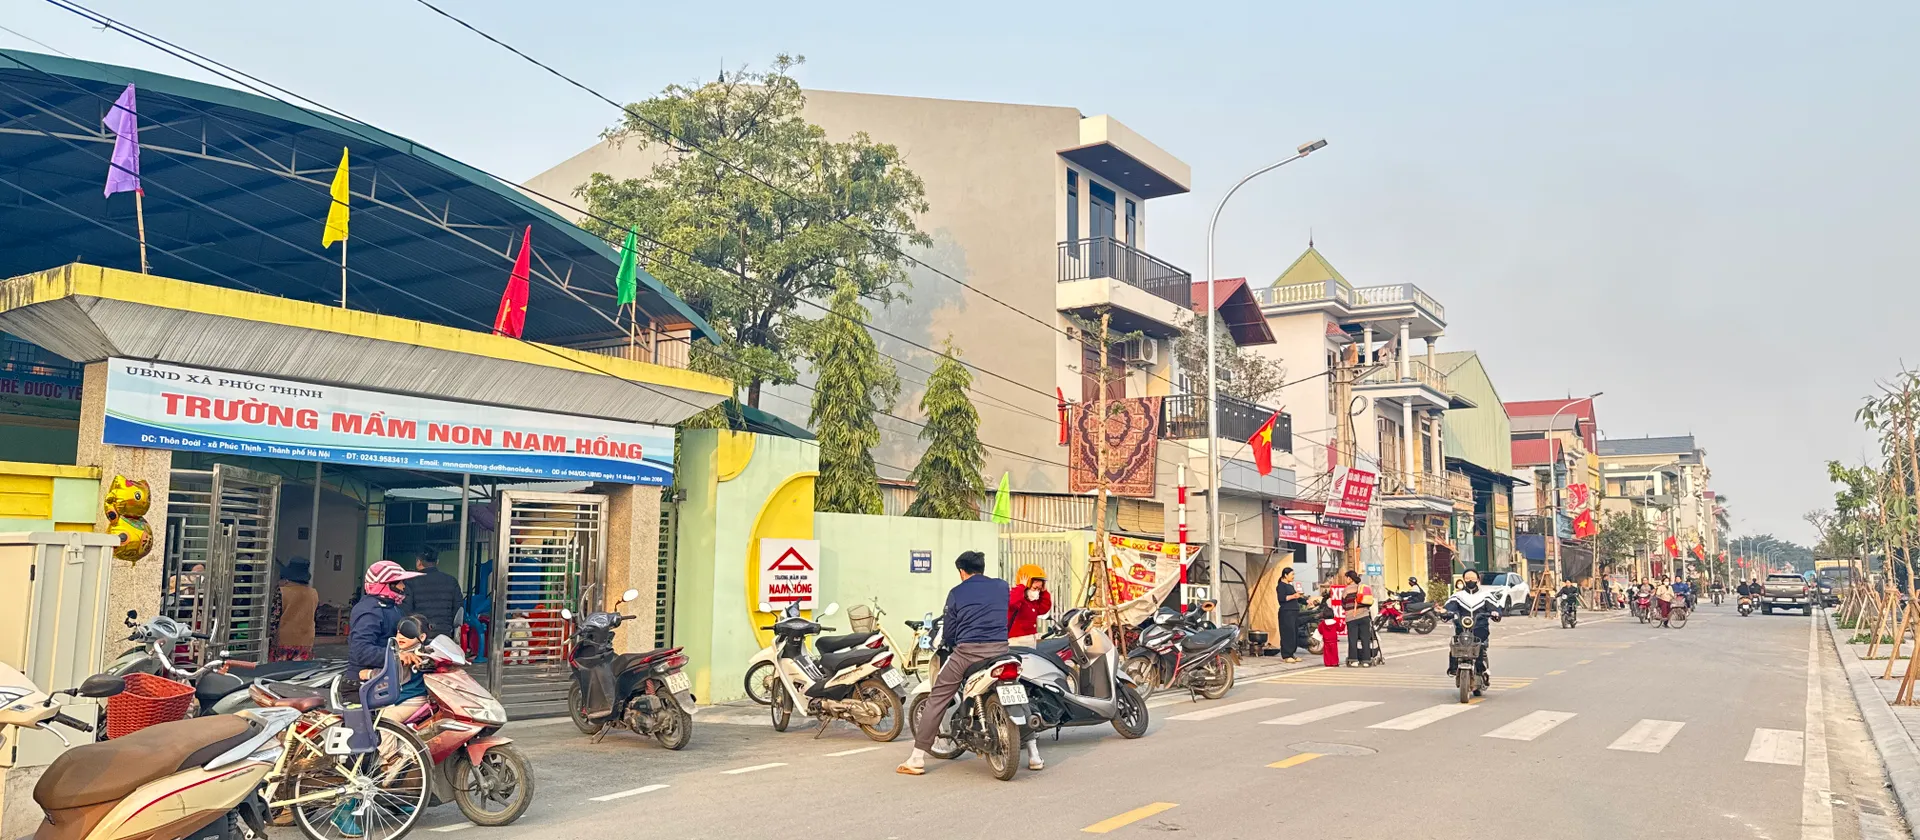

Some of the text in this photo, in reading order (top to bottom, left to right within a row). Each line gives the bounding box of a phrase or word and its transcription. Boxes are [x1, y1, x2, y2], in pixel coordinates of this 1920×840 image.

[0, 375, 19, 394] RẺ
[126, 366, 323, 398] UBND XÃ PHÚC THỊNH
[161, 392, 643, 460] TRƯỜNG MẦM NON NAM HỒNG
[159, 435, 180, 445] Thôn
[207, 440, 218, 449] xã
[219, 441, 239, 451] Phúc
[240, 443, 262, 454] Thịnh
[268, 445, 291, 455] Thành
[292, 447, 306, 458] phố
[306, 449, 317, 457] Hà
[318, 449, 331, 459] Nội
[419, 458, 440, 467] Email:
